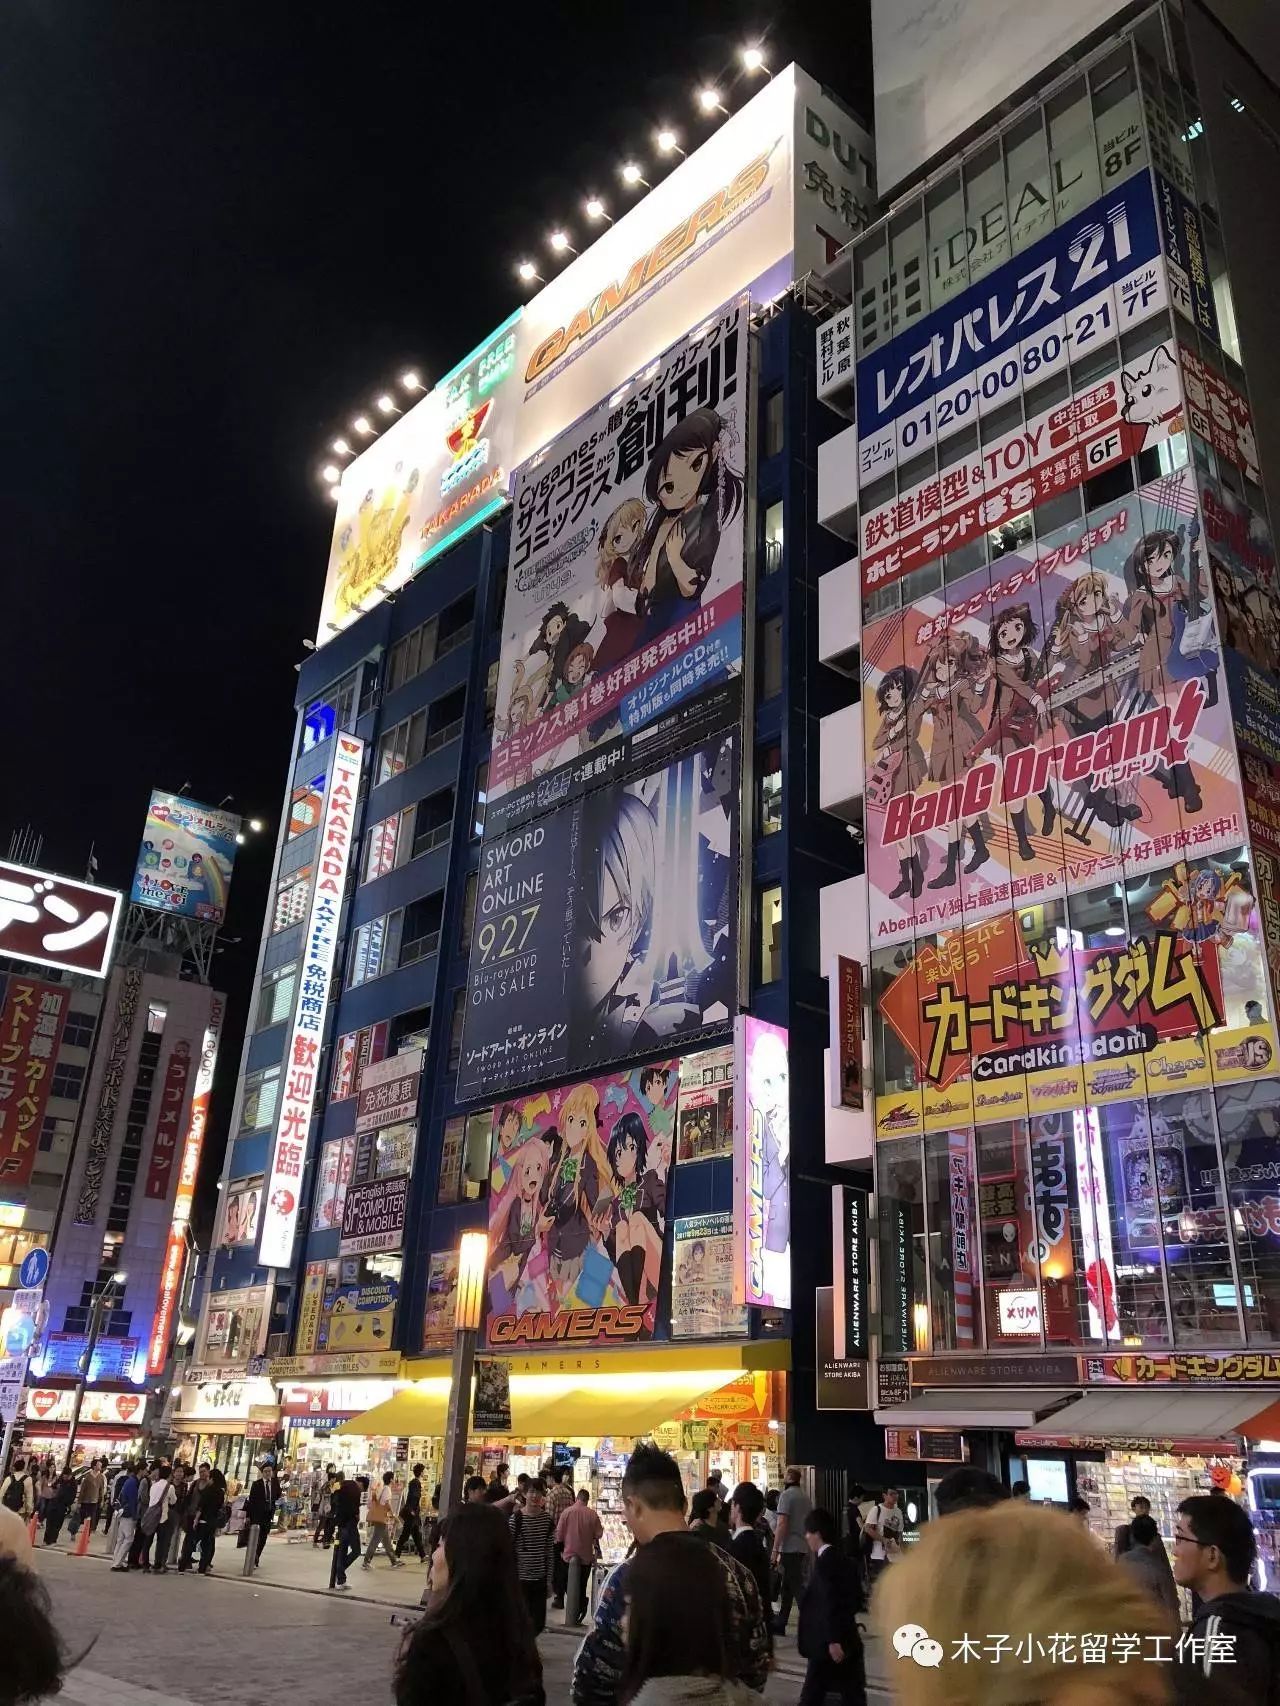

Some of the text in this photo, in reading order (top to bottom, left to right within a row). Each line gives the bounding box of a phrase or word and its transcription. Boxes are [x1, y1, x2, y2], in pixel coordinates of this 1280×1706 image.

[1104, 139, 1144, 178] 8F
[525, 150, 775, 383] GAMERS
[1121, 269, 1156, 295] 当ビル
[876, 201, 1132, 412] レオパレス21
[1122, 282, 1159, 317] 7F
[1169, 278, 1190, 307] 7F
[820, 327, 834, 386] 野村ビル
[836, 316, 851, 373] 秋葉原
[901, 298, 1113, 449] 0120-0080-21
[1067, 410, 1101, 439] 買取
[1192, 411, 1209, 435] 6F
[862, 437, 893, 461] フリー
[862, 448, 895, 473] コール
[1040, 450, 1081, 483] 秋葉原
[1089, 436, 1119, 465] 6F
[864, 423, 1045, 552] 鉄道模型 & TOY
[1042, 464, 1083, 494] 2号店
[421, 467, 504, 541] TAKARADA
[514, 474, 613, 570] コミックス
[317, 767, 355, 895] TAKARADA
[486, 827, 545, 868] SWORD
[482, 872, 544, 914] ONLINE
[484, 864, 513, 892] ART
[478, 904, 541, 965] 9.27
[297, 963, 329, 1032] 免税商店
[472, 971, 536, 1006] ON SALE
[1, 984, 34, 1063] ストーブ
[208, 999, 224, 1038] ADULT
[925, 934, 1220, 1081] カードキングダム
[466, 1023, 568, 1065] ソードアート・オンライン
[12, 1058, 47, 1154] カーペット
[360, 1194, 405, 1219] COMPUTER
[361, 1183, 385, 1201] English
[357, 1212, 404, 1235] & MOBILE
[361, 1285, 391, 1295] DISCOUNT
[850, 1200, 861, 1348] ALIENWARE STORE AKIBA
[336, 1300, 345, 1313] 2F
[488, 1303, 652, 1345] GAMERS
[824, 1361, 861, 1370] ALIENWARE
[824, 1370, 861, 1380] STORE AKIBA
[989, 1365, 1026, 1376] STORE
[1136, 1355, 1280, 1380] カードキングダム
